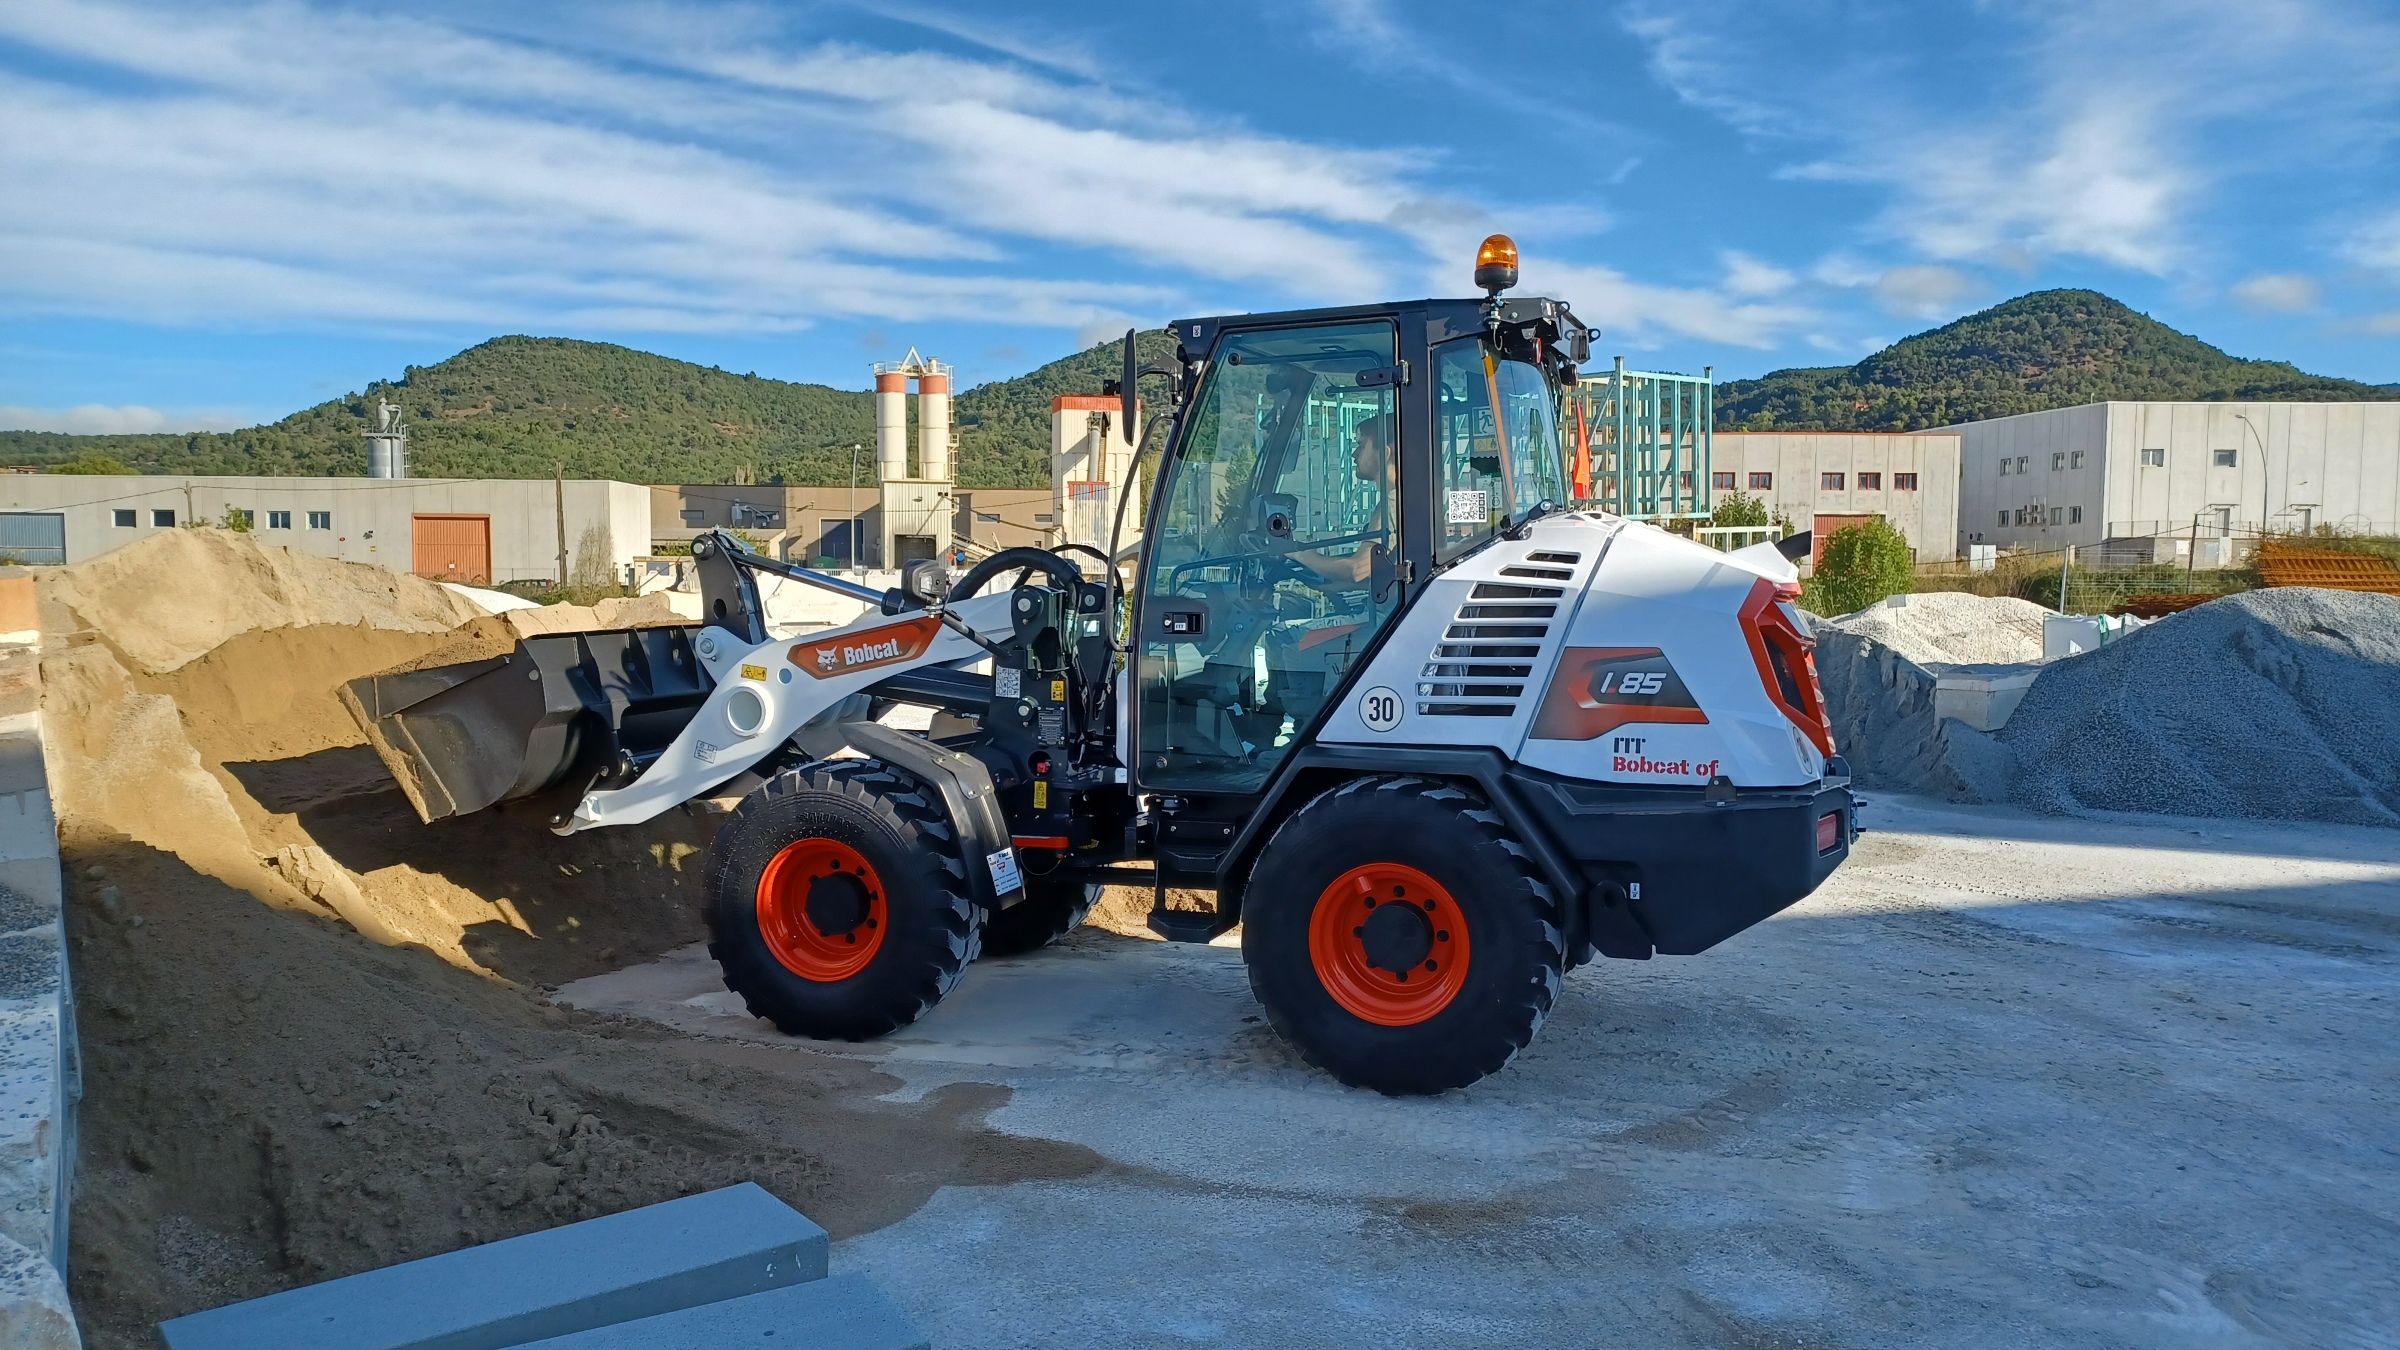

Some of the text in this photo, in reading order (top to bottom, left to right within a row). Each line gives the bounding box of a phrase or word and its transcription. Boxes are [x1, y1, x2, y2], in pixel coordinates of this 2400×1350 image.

[843, 638, 900, 666] Bobcat
[1600, 672, 1667, 695] L85
[1368, 696, 1394, 722] 30
[1613, 756, 1719, 777] Bobcat of
